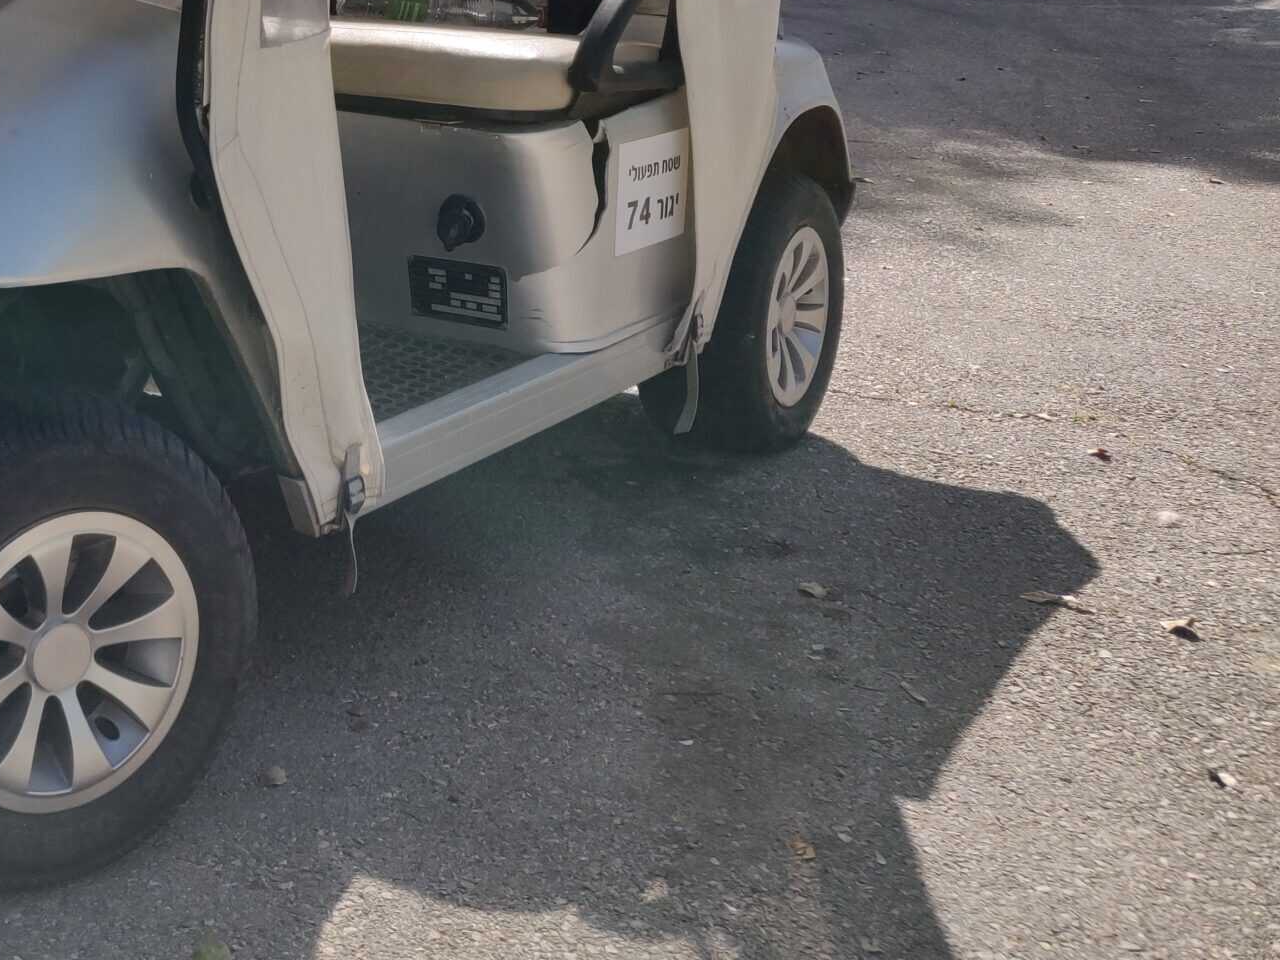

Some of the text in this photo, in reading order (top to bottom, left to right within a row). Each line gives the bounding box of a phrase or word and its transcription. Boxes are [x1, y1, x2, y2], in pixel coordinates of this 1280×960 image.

[628, 161, 660, 183] תפעולי
[627, 192, 680, 230] יגור 74
